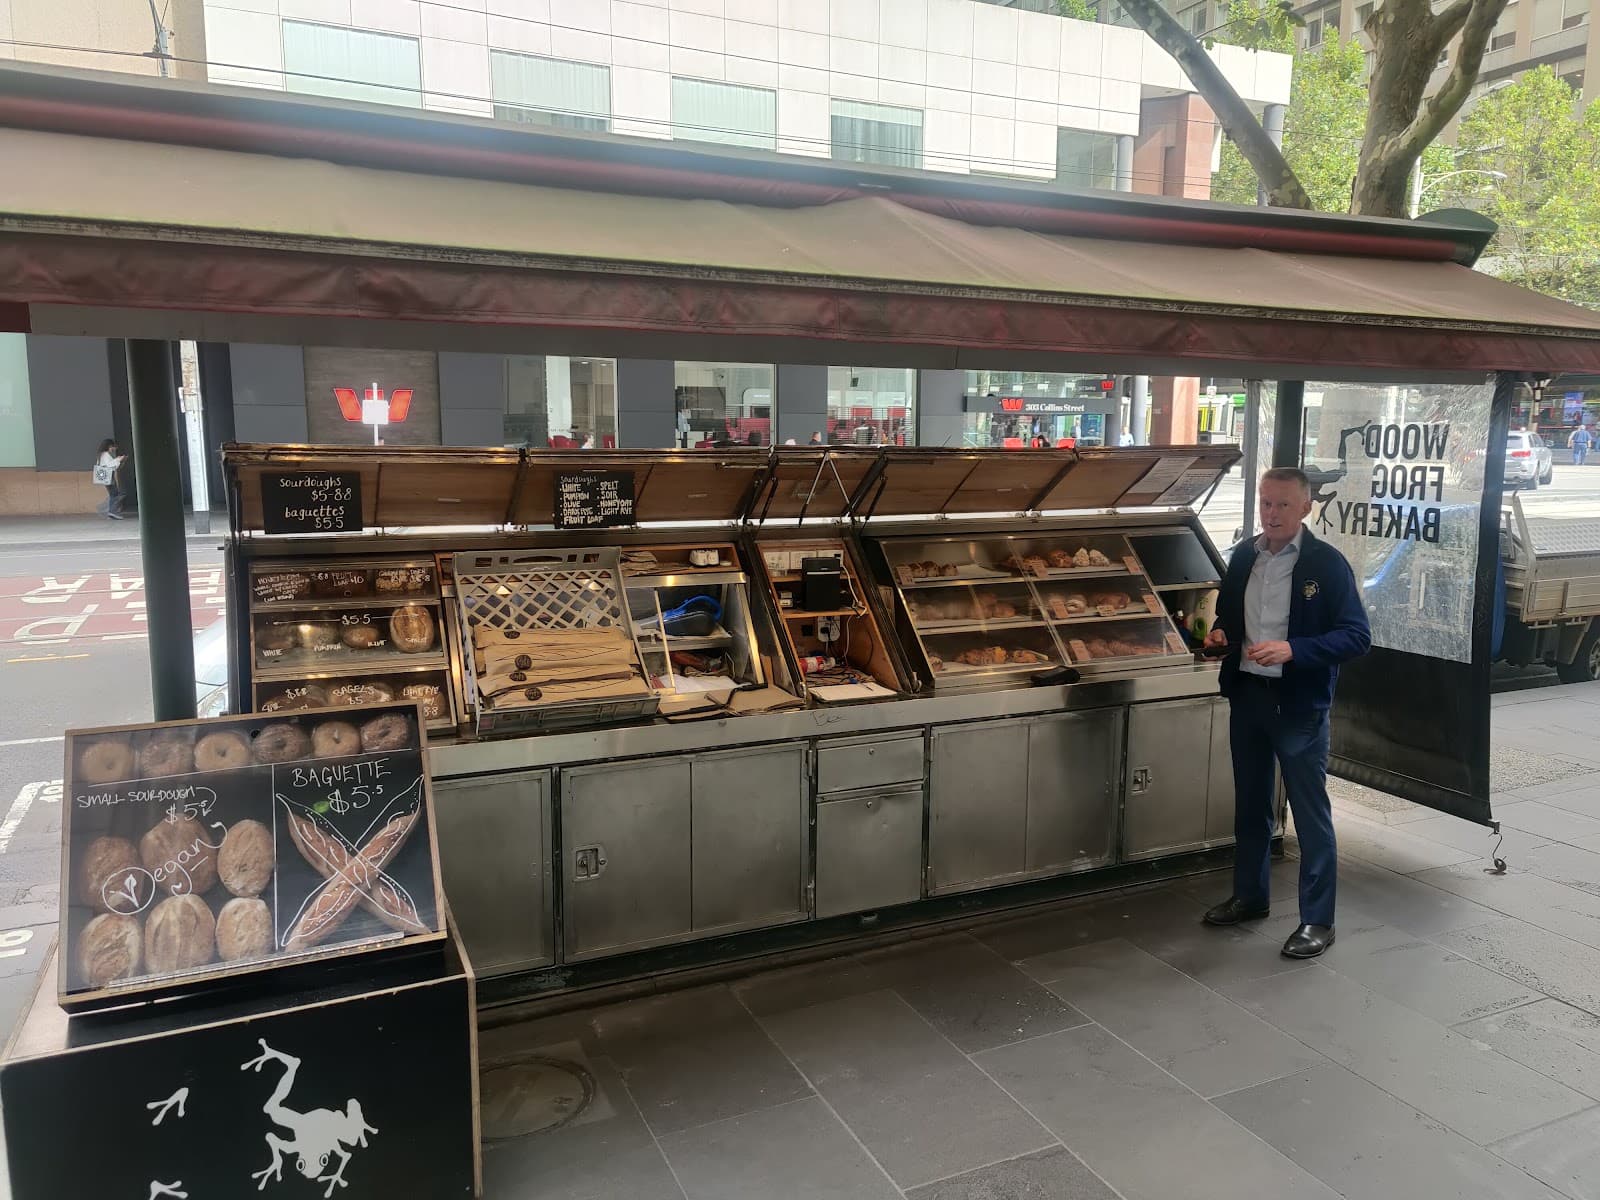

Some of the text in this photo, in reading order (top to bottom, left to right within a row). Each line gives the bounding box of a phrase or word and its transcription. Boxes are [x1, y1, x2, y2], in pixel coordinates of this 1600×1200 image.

[1025, 403, 1040, 411] 303
[1040, 403, 1063, 412] Collins
[1063, 403, 1085, 412] Street
[561, 483, 582, 493] WHITE
[600, 480, 619, 491] SPELT
[563, 500, 581, 508] OLIVE
[284, 505, 345, 521] baguettes
[601, 507, 619, 516] LIGHT
[563, 515, 604, 525] FRUIT LOAF
[332, 685, 375, 697] BAGELS
[291, 758, 392, 788] BAGUETTE
[77, 785, 195, 808] SMALL SOURDOUGH
